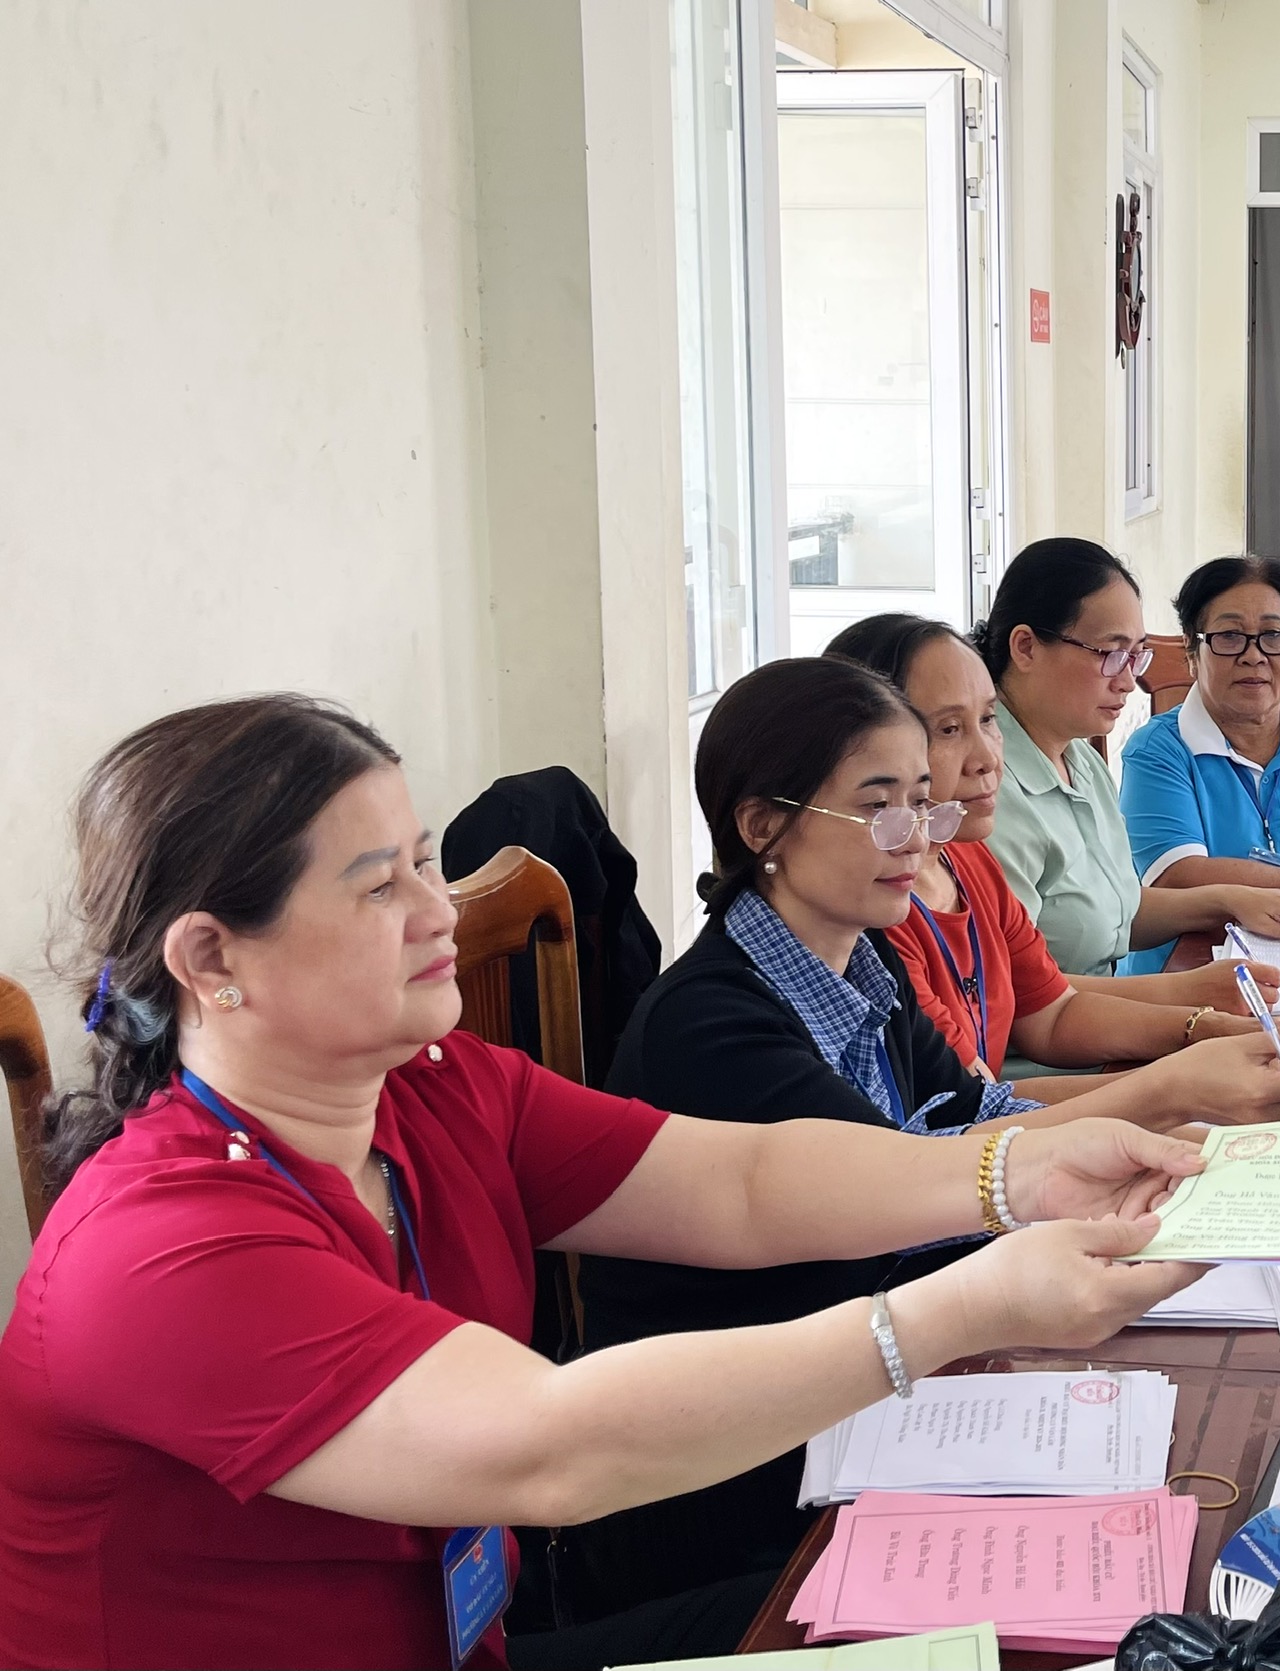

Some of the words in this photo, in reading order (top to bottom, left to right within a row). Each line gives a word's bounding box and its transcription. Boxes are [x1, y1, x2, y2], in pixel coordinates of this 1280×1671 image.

[919, 1529, 935, 1542] Ông
[951, 1528, 967, 1541] Ông
[983, 1526, 998, 1540] Ông
[1015, 1525, 1029, 1538] Ông
